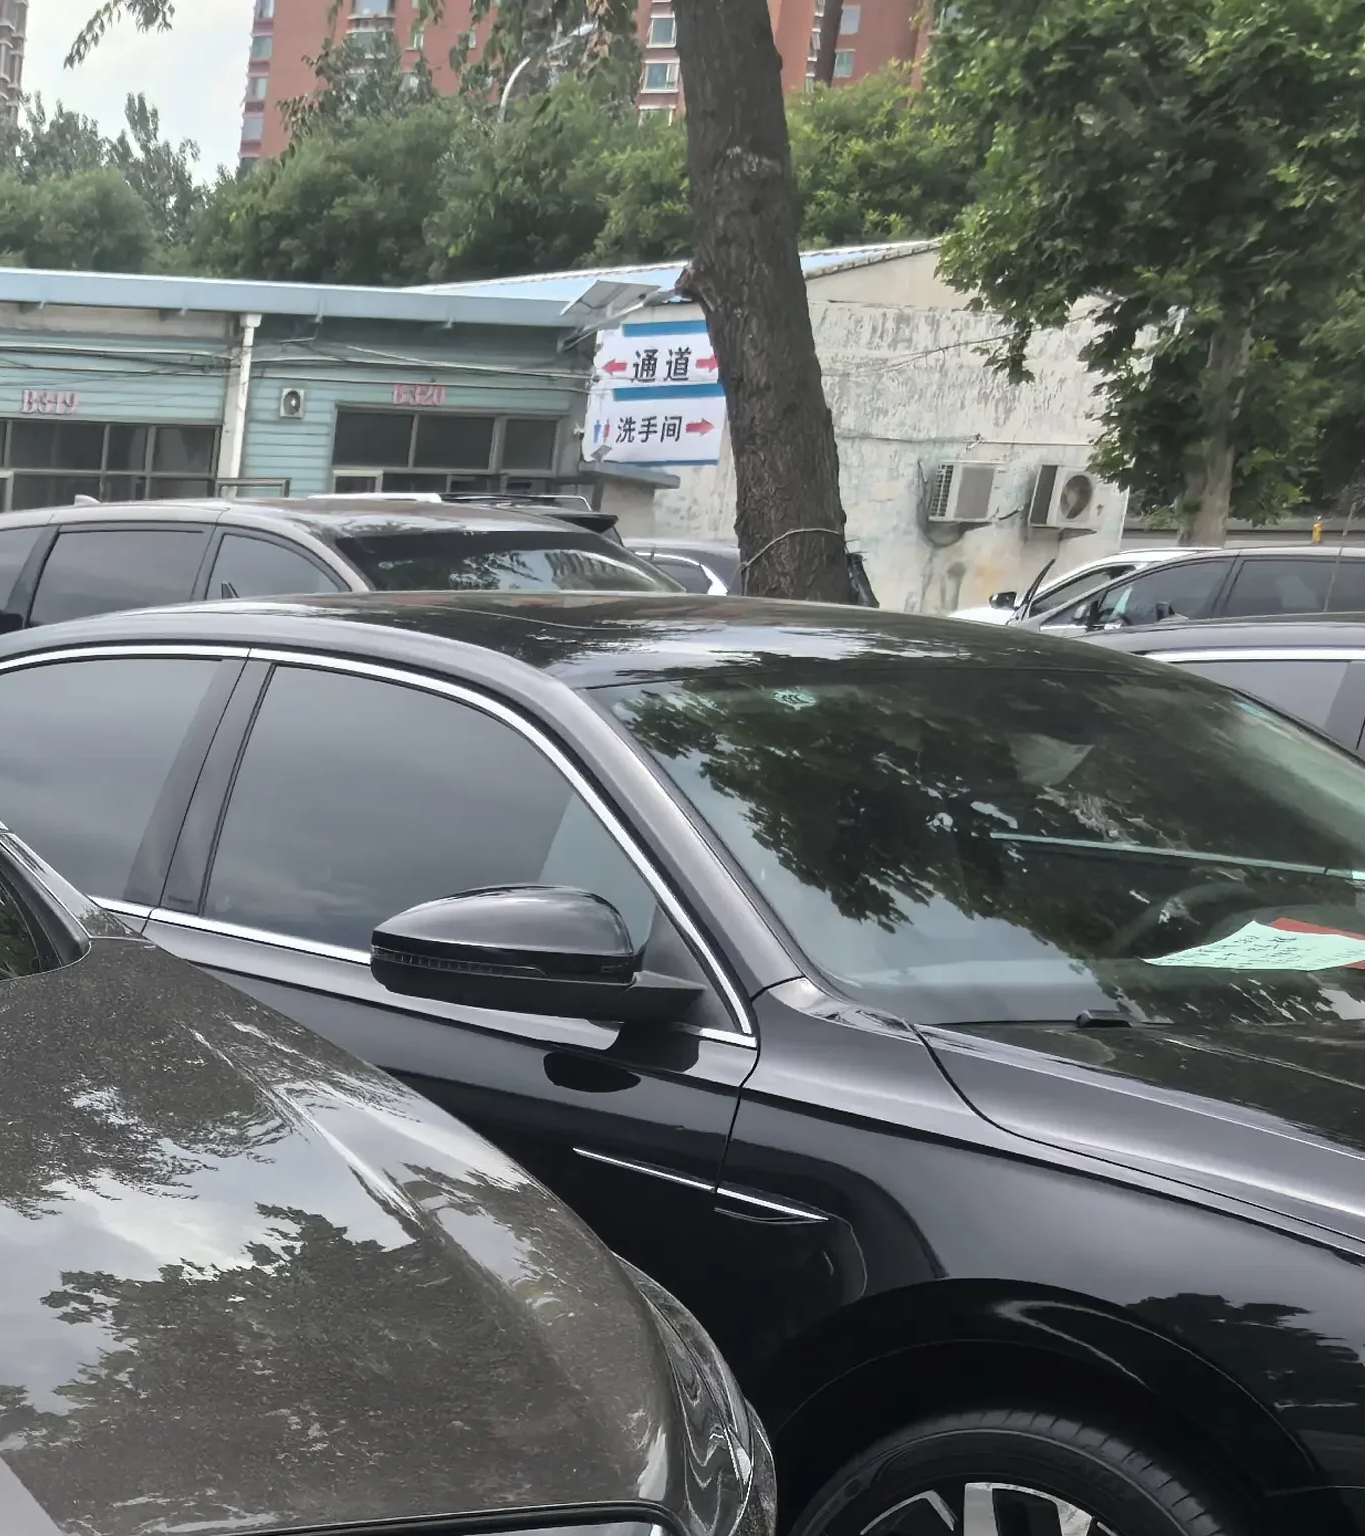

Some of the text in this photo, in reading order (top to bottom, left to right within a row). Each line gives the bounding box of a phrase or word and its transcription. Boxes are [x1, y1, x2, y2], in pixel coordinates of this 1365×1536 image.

[631, 346, 692, 383] 通道
[615, 416, 683, 443] 洗手间
